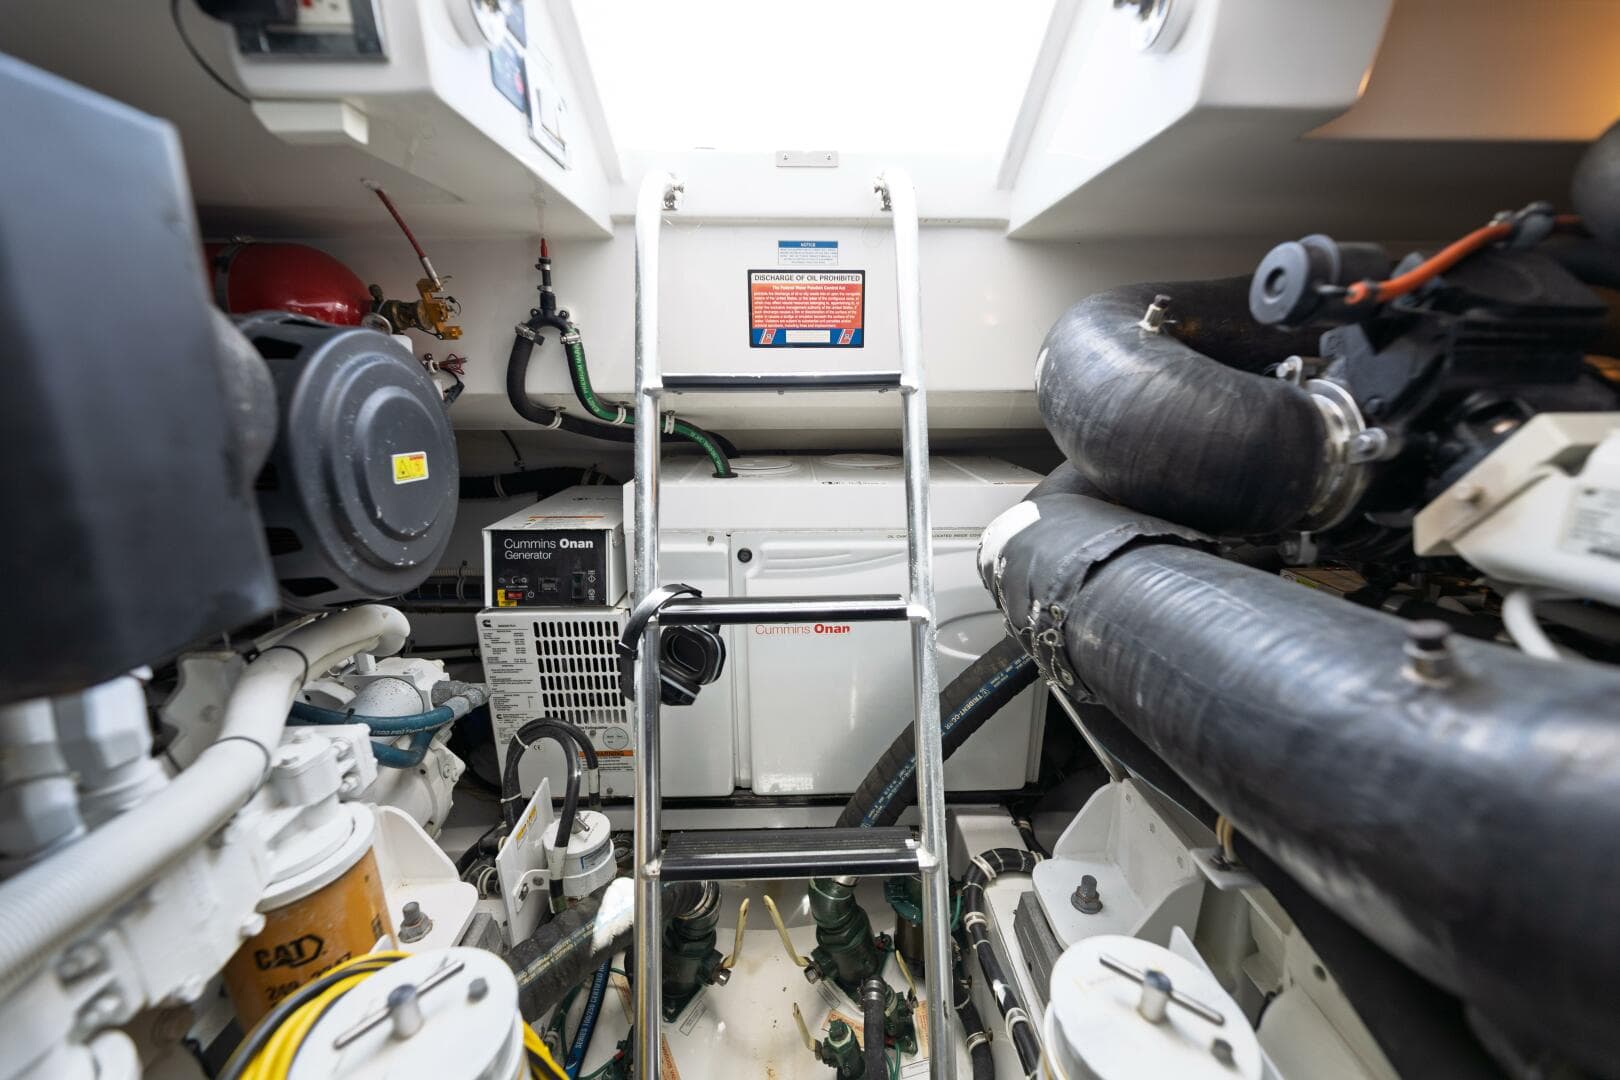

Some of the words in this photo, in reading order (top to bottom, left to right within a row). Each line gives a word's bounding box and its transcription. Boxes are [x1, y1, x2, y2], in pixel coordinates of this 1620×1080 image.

[754, 274, 795, 282] DISCHARGE
[796, 274, 804, 282] OF
[806, 274, 817, 282] OIL
[819, 274, 861, 282] PROHIBITED
[504, 538, 556, 549] Cummins
[559, 538, 594, 549] Onan
[504, 550, 552, 560] Generator
[755, 624, 811, 635] Cummins
[813, 623, 850, 634] Onan
